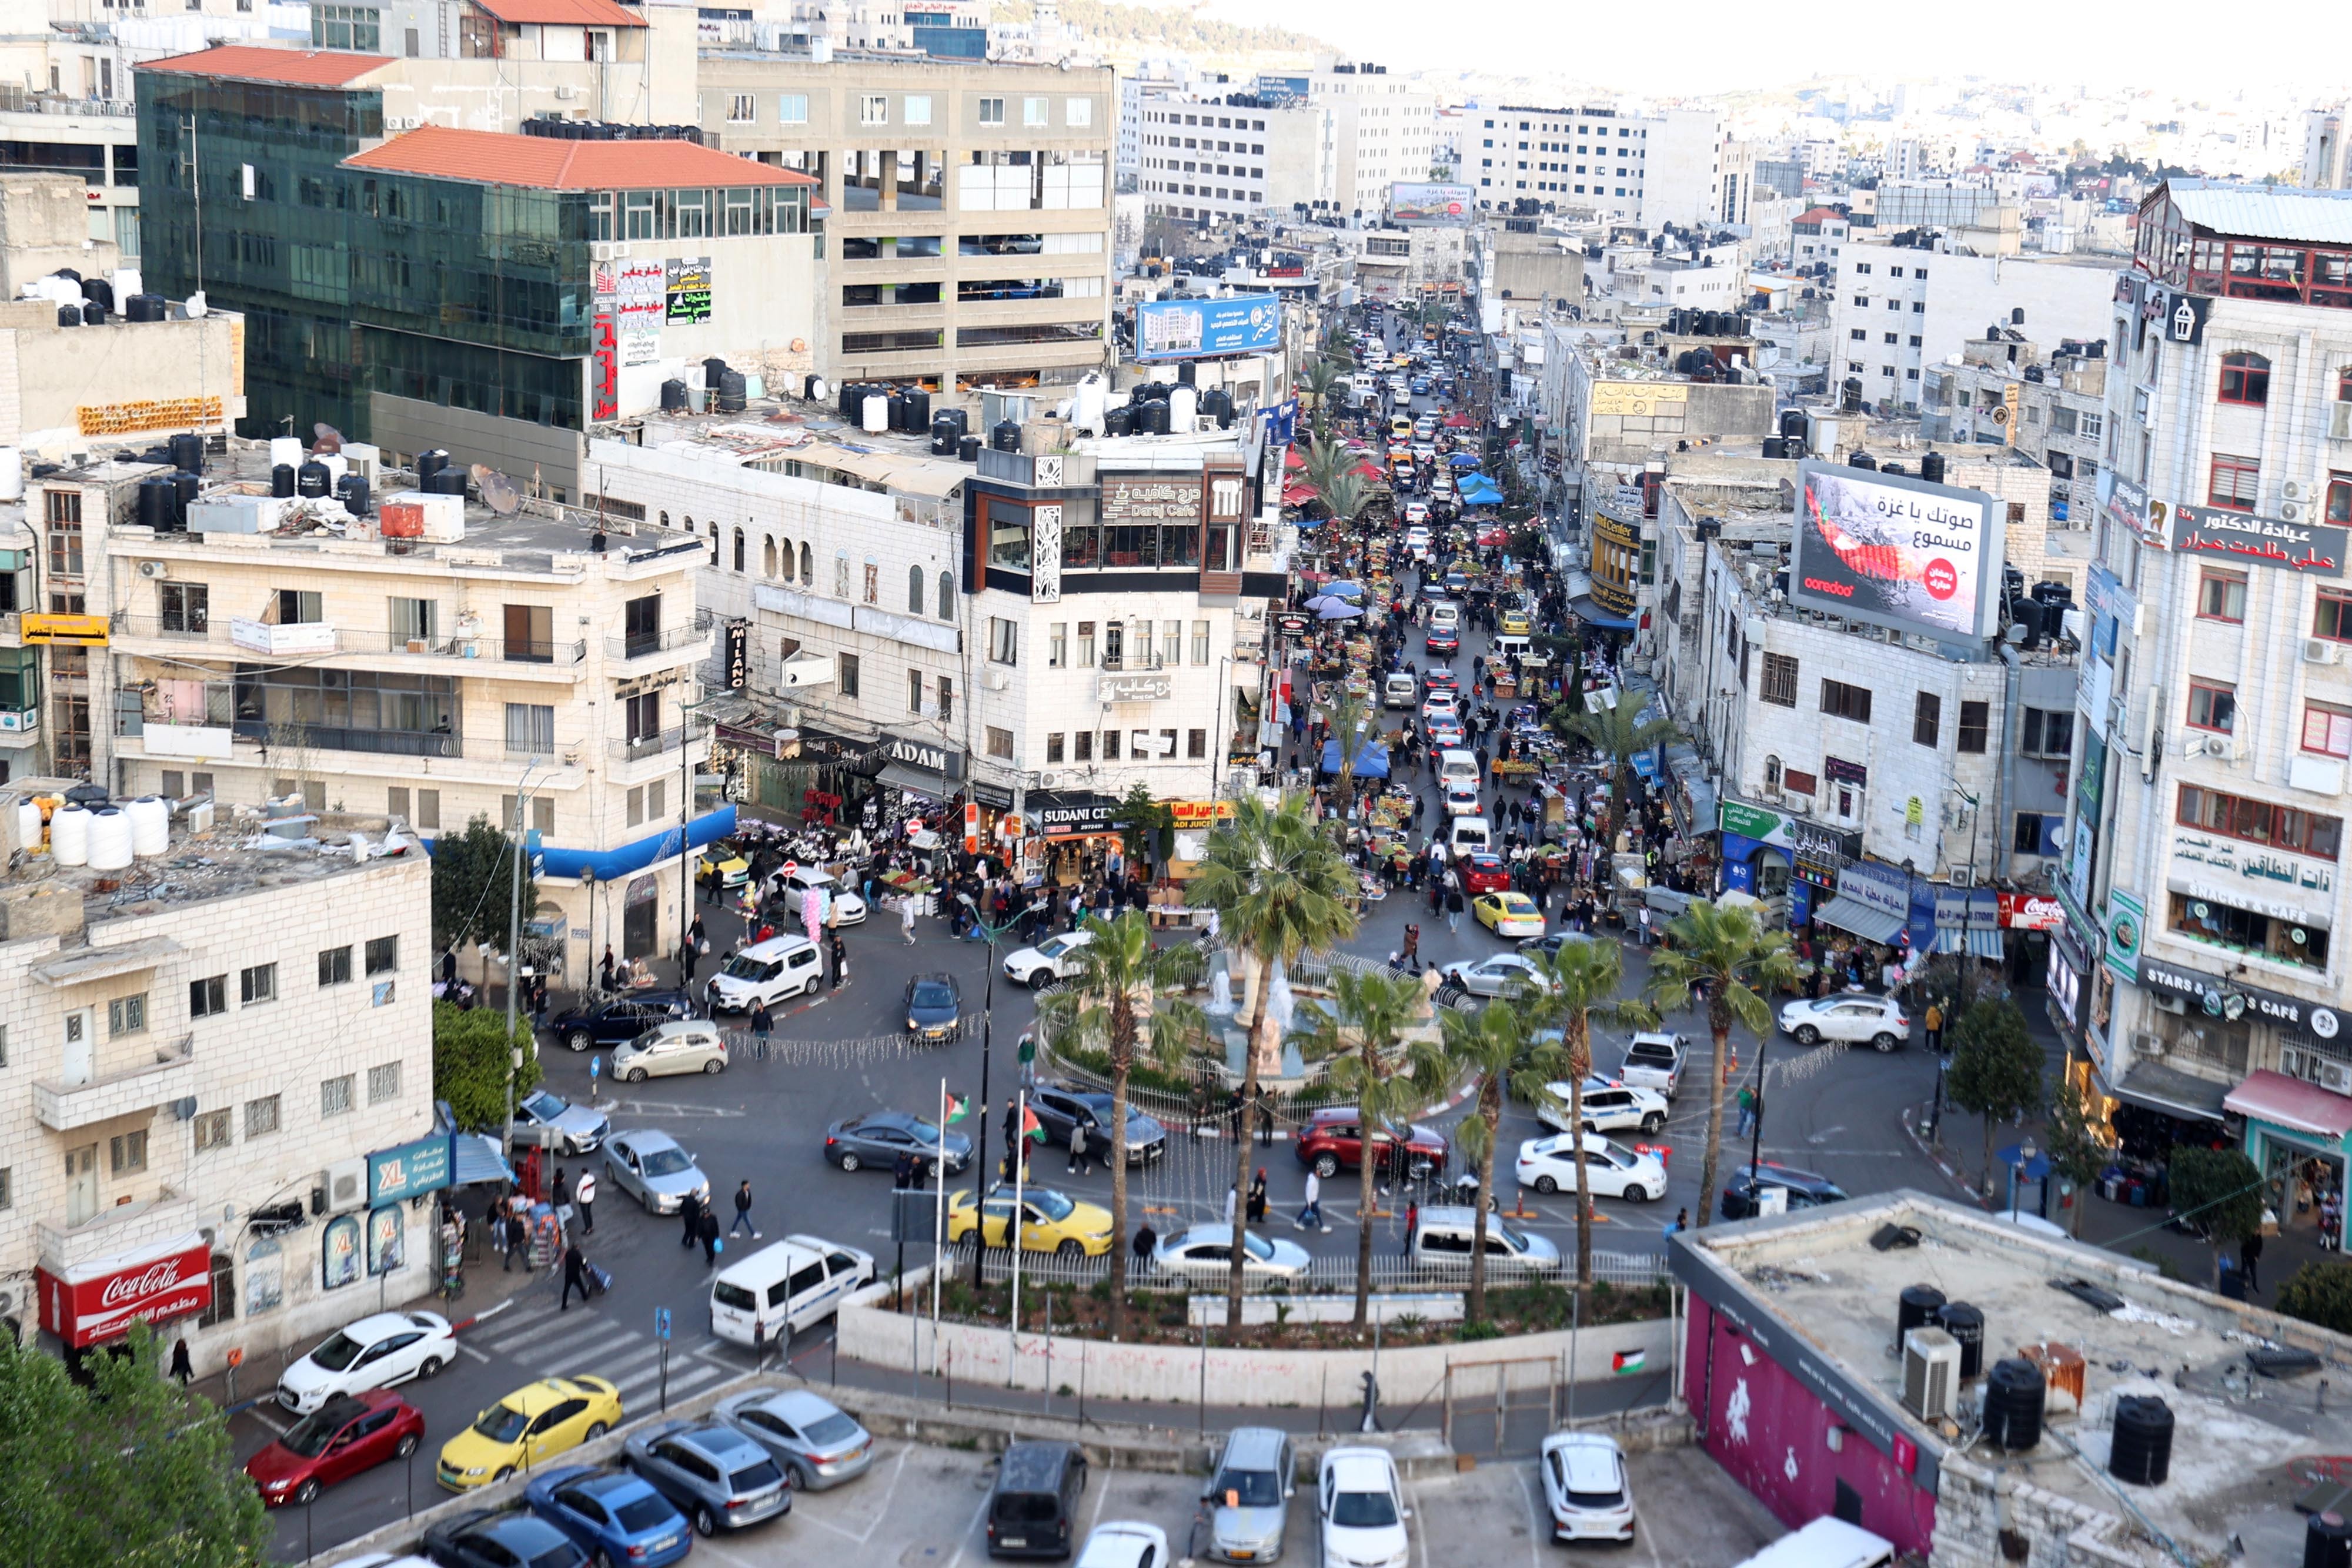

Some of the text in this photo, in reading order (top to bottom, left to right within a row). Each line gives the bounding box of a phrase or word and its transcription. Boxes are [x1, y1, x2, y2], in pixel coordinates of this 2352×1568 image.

[1131, 483, 1201, 504] درج كافيه
[1131, 504, 1164, 520] Daraj
[1877, 496, 1973, 530] صوتك يا غزة
[1607, 520, 1633, 537] Center
[2203, 514, 2311, 543] عيادة الدكتور
[1913, 530, 1972, 551] مسموع
[2179, 530, 2336, 571] علي طلعت عرار
[1929, 567, 1953, 581] رمضان
[1929, 579, 1952, 591] مبارك
[1805, 577, 1855, 597] ooredoo
[1292, 615, 1309, 624] Smile
[731, 628, 744, 688] MILANO
[1115, 678, 1156, 696] كافيه
[891, 741, 946, 771] ADAM
[1044, 808, 1090, 823] SUDANI
[2301, 868, 2330, 892] ذات
[2187, 882, 2247, 908] SNACKS
[2253, 901, 2263, 913] &
[1974, 911, 1994, 922] STORE
[2147, 968, 2204, 995] STARS &
[378, 1158, 407, 1191] XL
[379, 1218, 396, 1240] XL
[101, 1256, 182, 1308] Coca-Cola
[155, 1296, 199, 1320] مطعم
